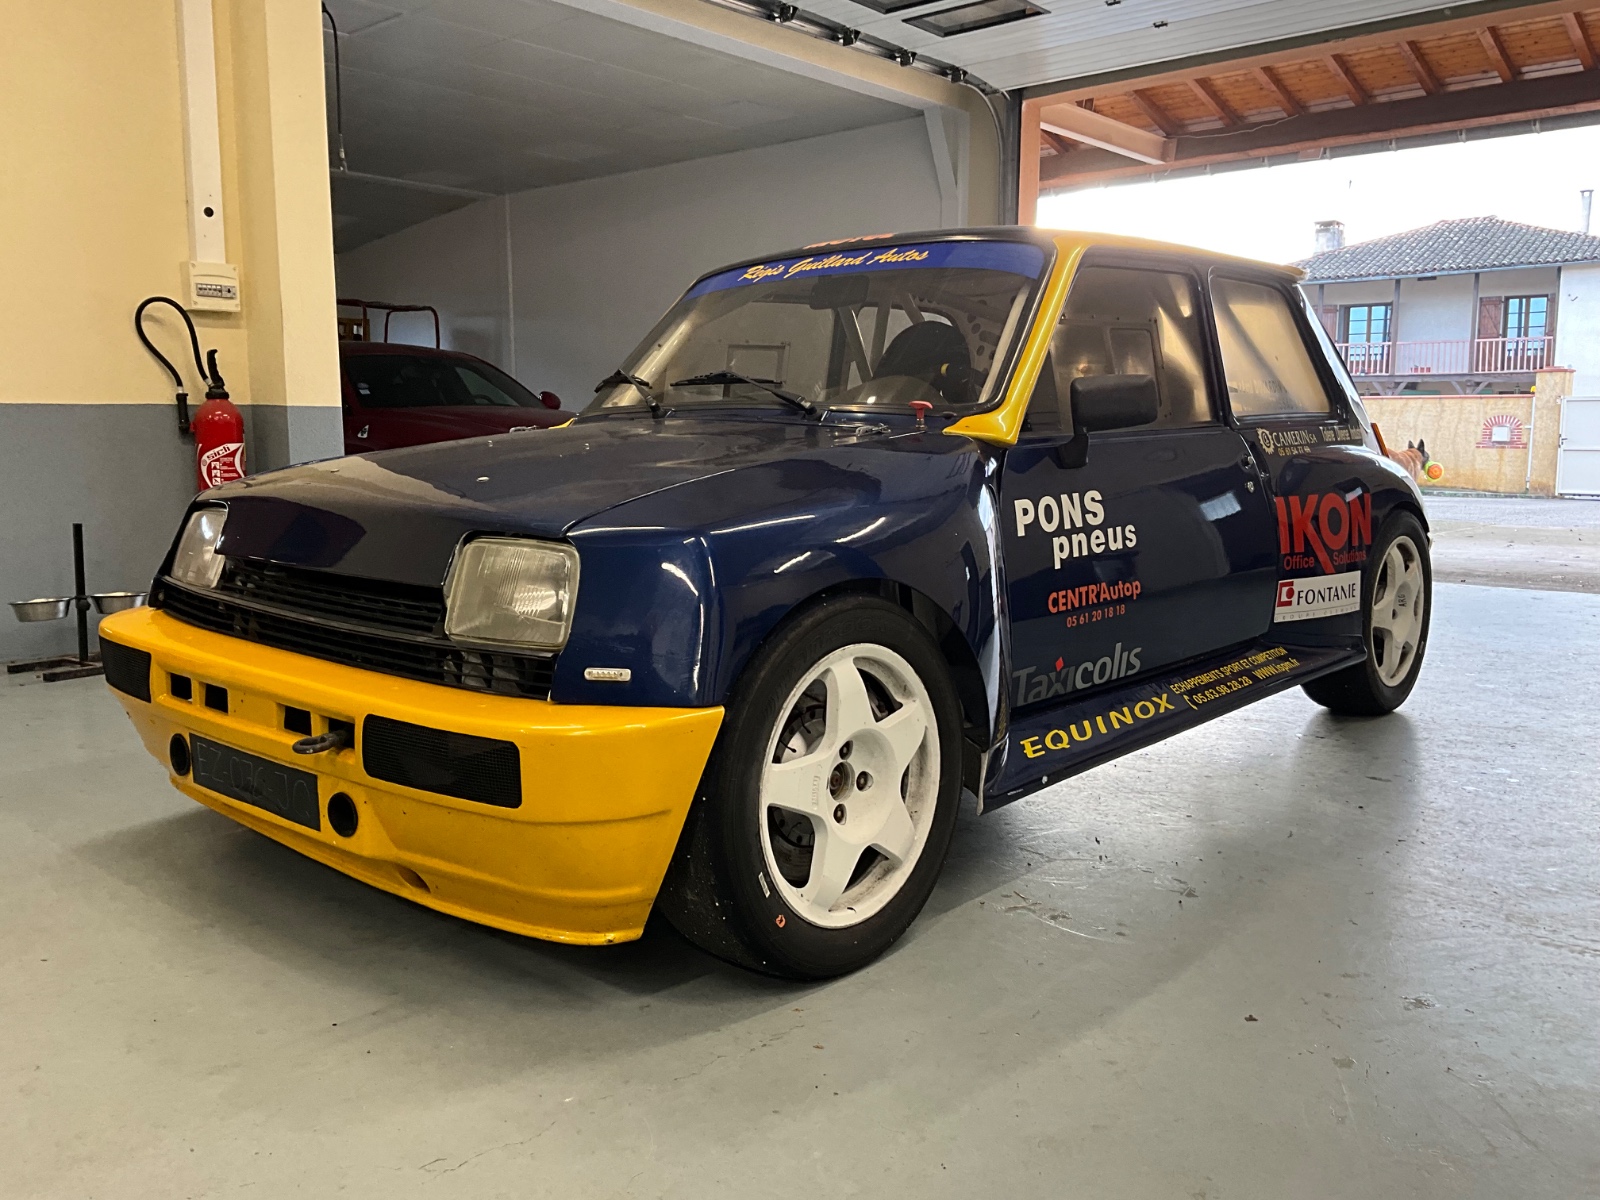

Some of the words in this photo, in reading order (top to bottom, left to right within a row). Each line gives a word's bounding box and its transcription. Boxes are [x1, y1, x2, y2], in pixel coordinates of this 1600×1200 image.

[1272, 430, 1310, 447] CAMERIN
[1014, 490, 1105, 537] PONS
[1275, 492, 1372, 574] IKON
[1052, 524, 1137, 570] pneus
[1283, 555, 1315, 570] Office
[1333, 550, 1367, 566] Solutions
[1047, 579, 1142, 614] CENTR'Autop
[1066, 615, 1078, 628] 05
[1079, 612, 1089, 625] 61
[1092, 609, 1102, 622] 20
[1104, 606, 1114, 620] 18
[1116, 603, 1126, 617] 18
[1297, 583, 1356, 606] FONTANIE
[1011, 642, 1142, 707] Taxicolis
[1169, 669, 1225, 694] ECHAPPEMENTS
[1219, 661, 1244, 676] SPORT
[1240, 658, 1252, 669] ET
[1248, 646, 1288, 665] COMPETITION
[1020, 693, 1175, 759] EQUINOX
